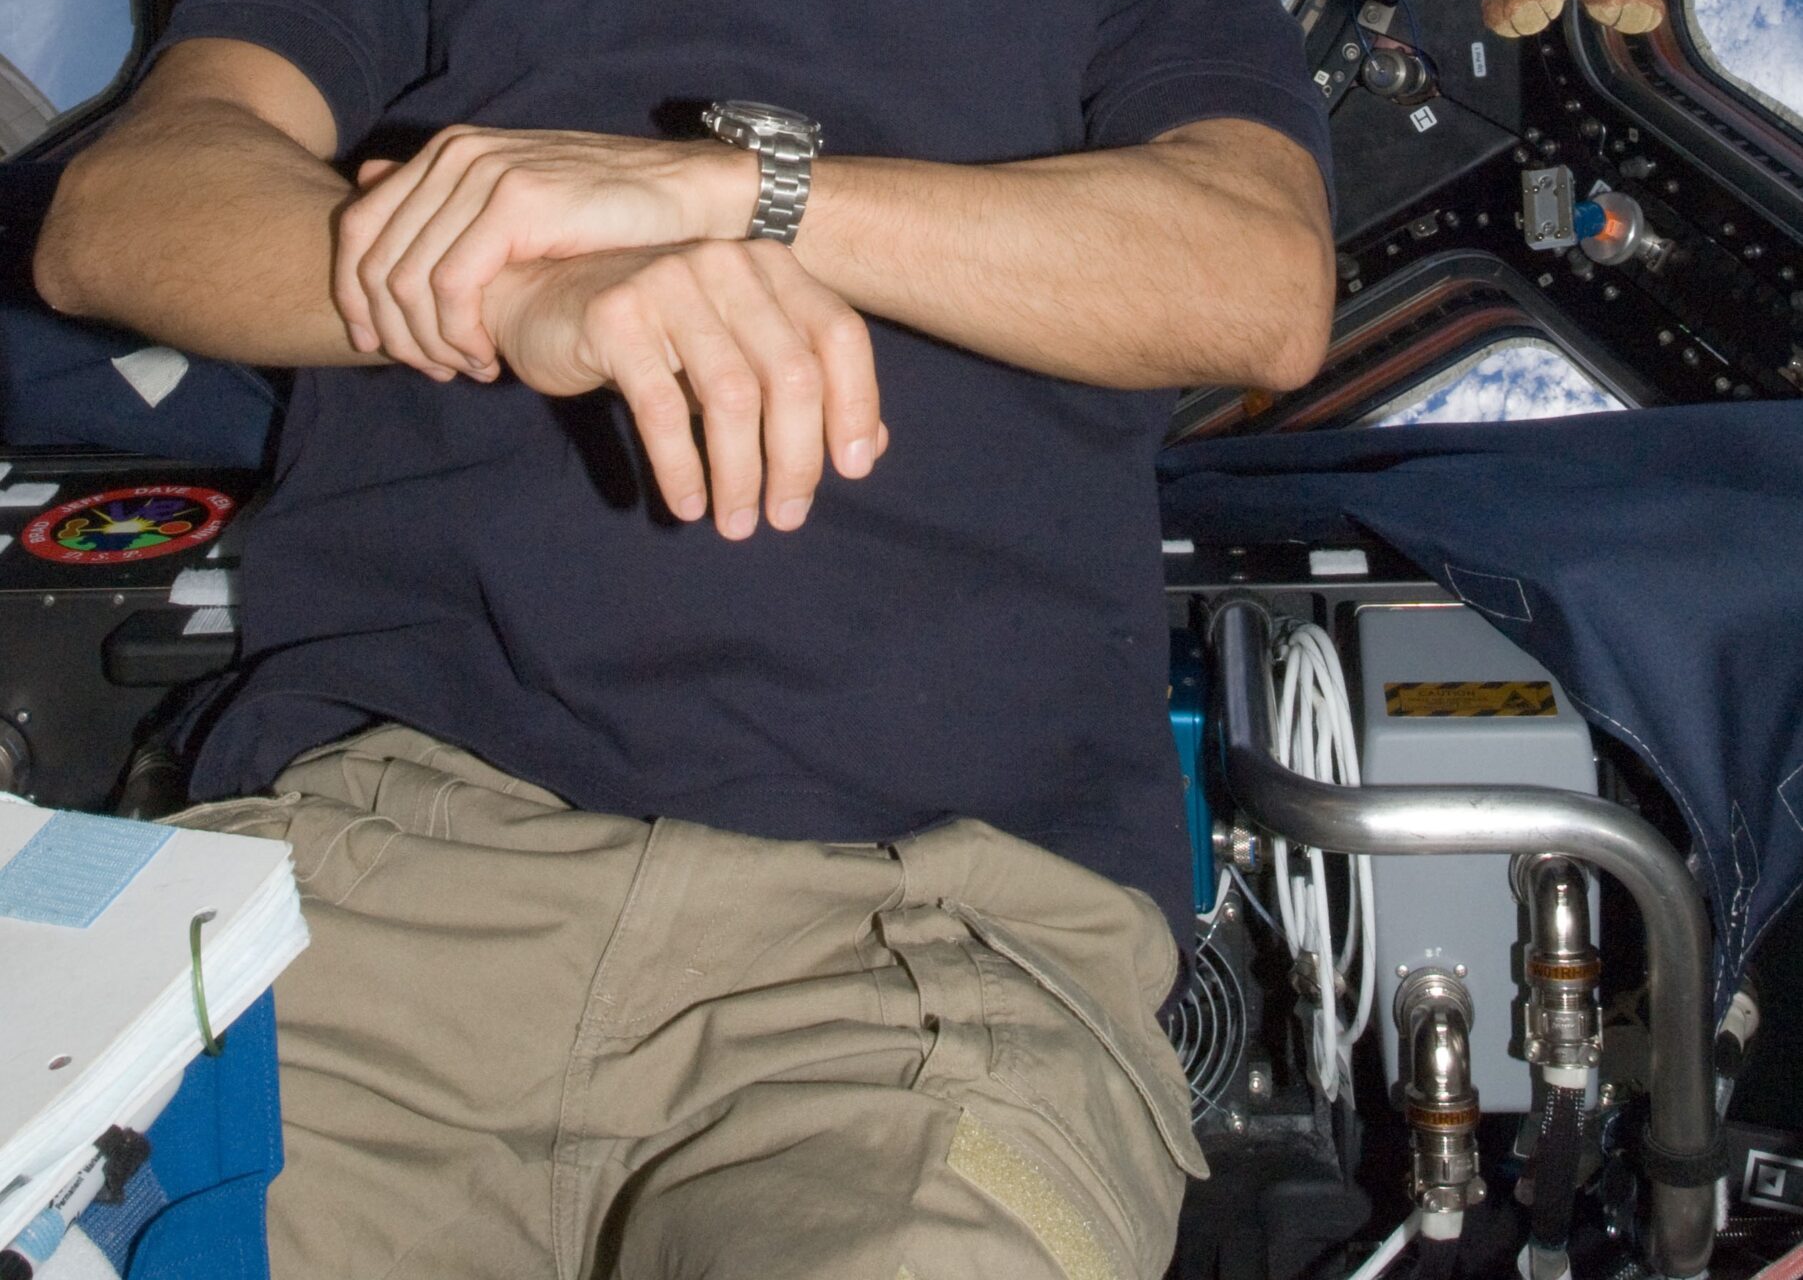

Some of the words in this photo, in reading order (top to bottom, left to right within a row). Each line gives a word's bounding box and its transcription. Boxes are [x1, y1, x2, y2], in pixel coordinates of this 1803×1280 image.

[1413, 108, 1433, 129] H
[133, 486, 192, 495] DAVE
[60, 493, 104, 513] JEFF
[28, 519, 49, 544] BRAD
[1418, 688, 1475, 697] CAUTION
[54, 1176, 86, 1210] Permanent
[85, 1152, 104, 1174] Marke
